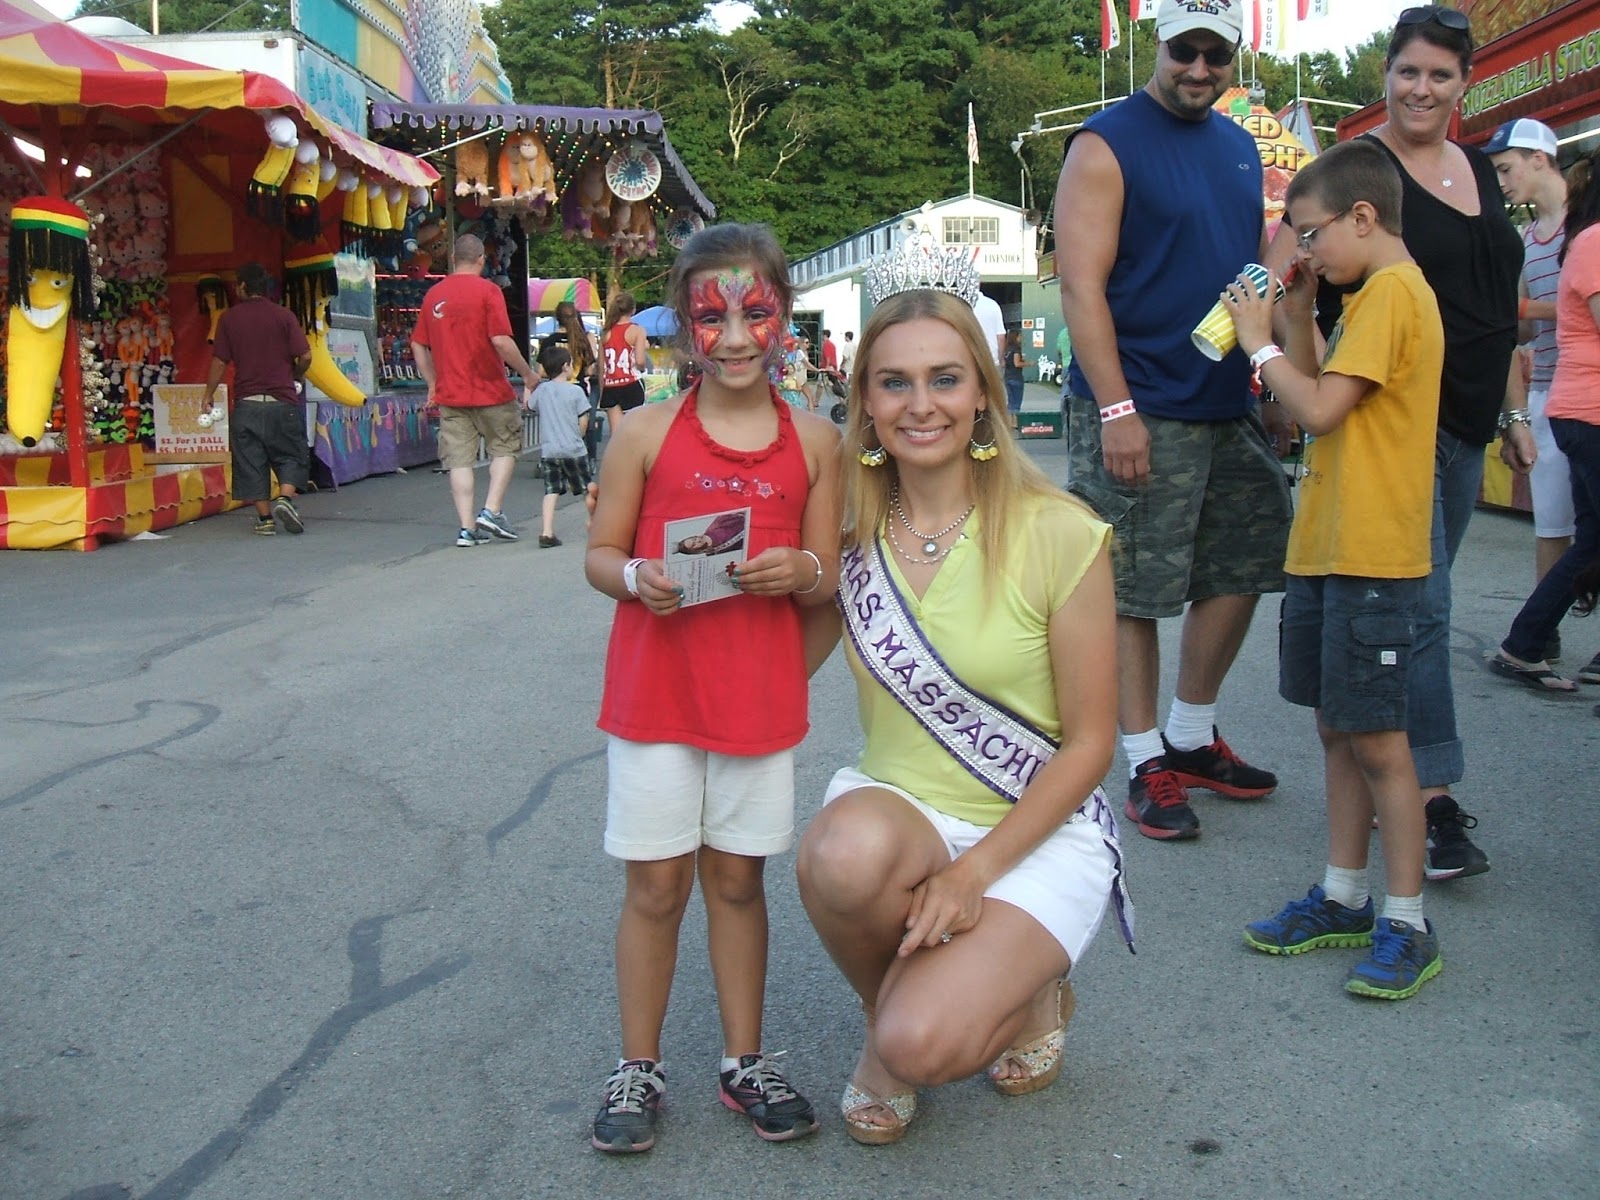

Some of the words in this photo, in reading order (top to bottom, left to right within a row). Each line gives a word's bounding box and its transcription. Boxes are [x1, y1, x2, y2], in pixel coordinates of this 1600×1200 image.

[1265, 7, 1273, 46] DOUGH
[1463, 52, 1552, 120] MOZZARELLA
[984, 253, 1020, 264] LIVESTOCK
[605, 347, 630, 375] 34
[176, 437, 190, 445] For
[200, 436, 224, 444] BALL
[197, 445, 226, 453] BALLS
[842, 543, 885, 631] MRS.
[870, 624, 1050, 789] MASSACHU
